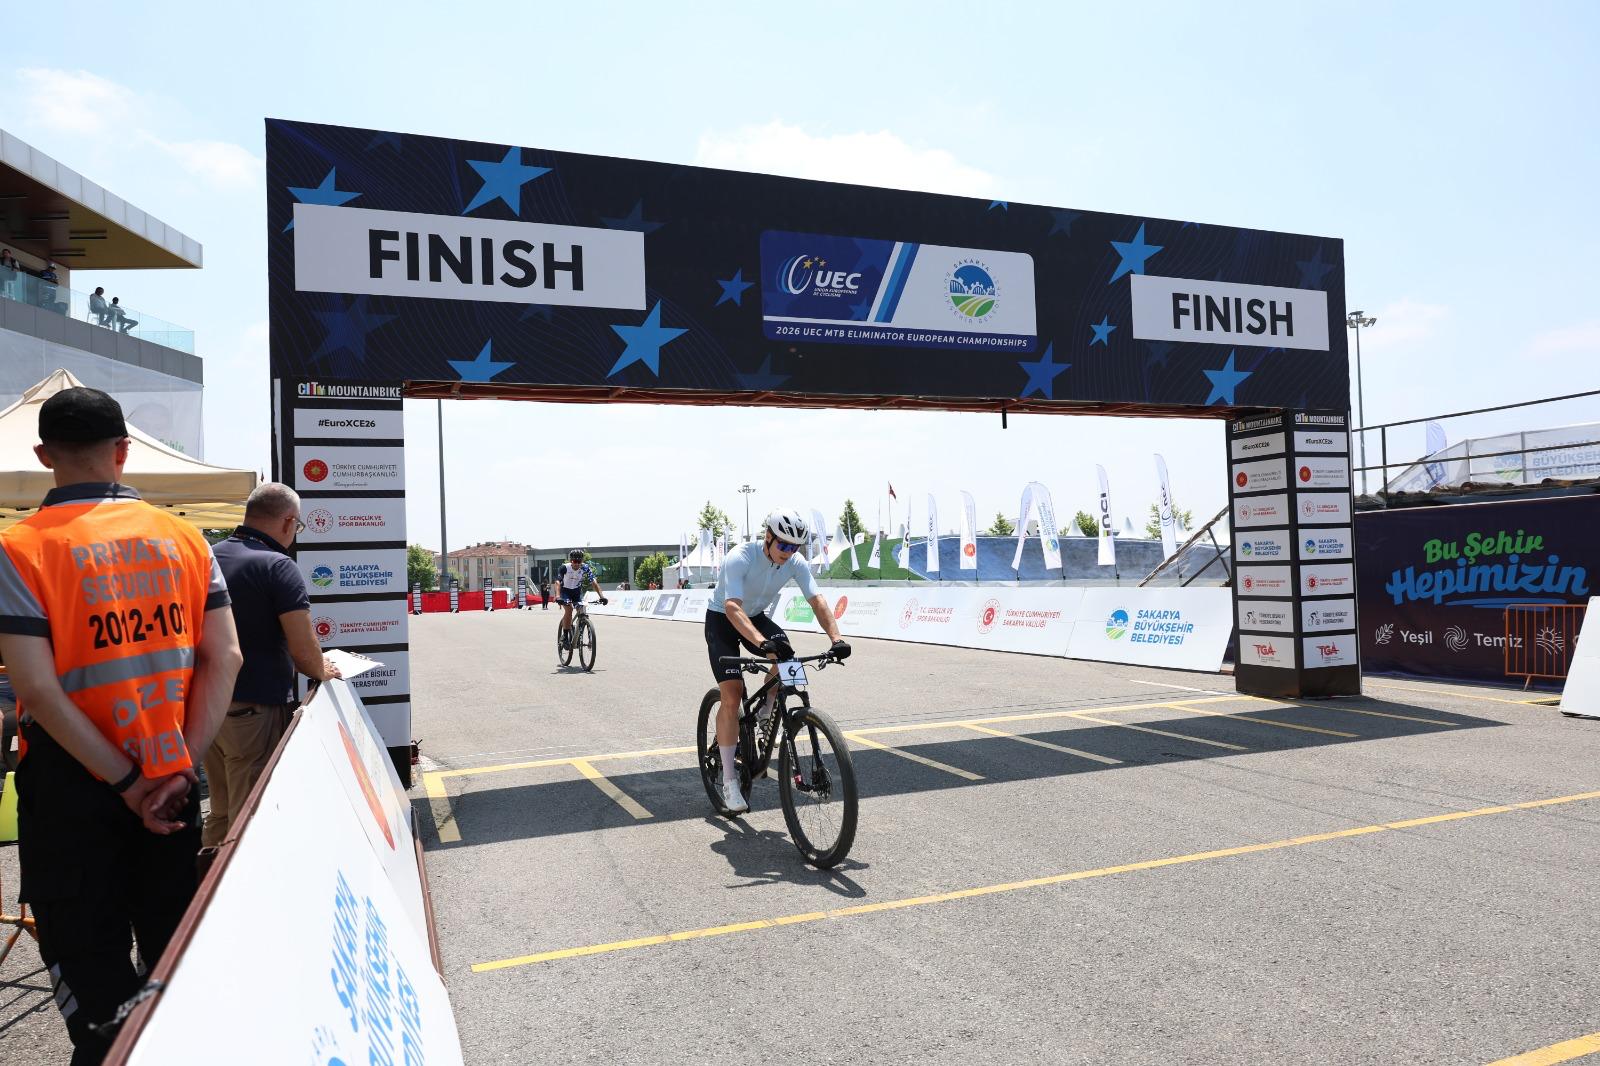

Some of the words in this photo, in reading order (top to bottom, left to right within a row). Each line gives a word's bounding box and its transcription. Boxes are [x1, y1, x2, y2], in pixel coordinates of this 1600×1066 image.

[368, 228, 584, 292] FINISH
[815, 270, 862, 290] UEC
[1172, 292, 1294, 337] FINISH
[776, 326, 800, 335] 2026
[803, 328, 822, 336] UEC
[824, 329, 845, 337] MTB
[847, 330, 905, 340] ELIMINATOR
[907, 333, 955, 344] EUROPEAN
[956, 336, 1028, 347] CHAMPIONSHIPS
[328, 385, 402, 397] MOUNTAINBIKE
[318, 419, 376, 428] #EuroXCE26
[71, 537, 181, 570] PRIVATE
[1423, 539, 1459, 564] Bu
[1463, 529, 1544, 565] Şehir
[339, 564, 380, 572] SAKARYA
[339, 571, 393, 580] BÜYÜKŞEHİR
[82, 568, 182, 605] SECURITY
[339, 578, 388, 587] BELEDİYESİ
[1385, 554, 1590, 606] Hepimizin
[1137, 609, 1181, 620] SAKARYA
[1134, 619, 1194, 633] BÜYÜKŞEHİR
[1130, 632, 1185, 645] BELEDİYESİ
[1400, 630, 1433, 646] Yeşil
[1474, 632, 1523, 648] Temiz
[370, 669, 396, 678] BİSİKLET
[787, 665, 797, 677] 6
